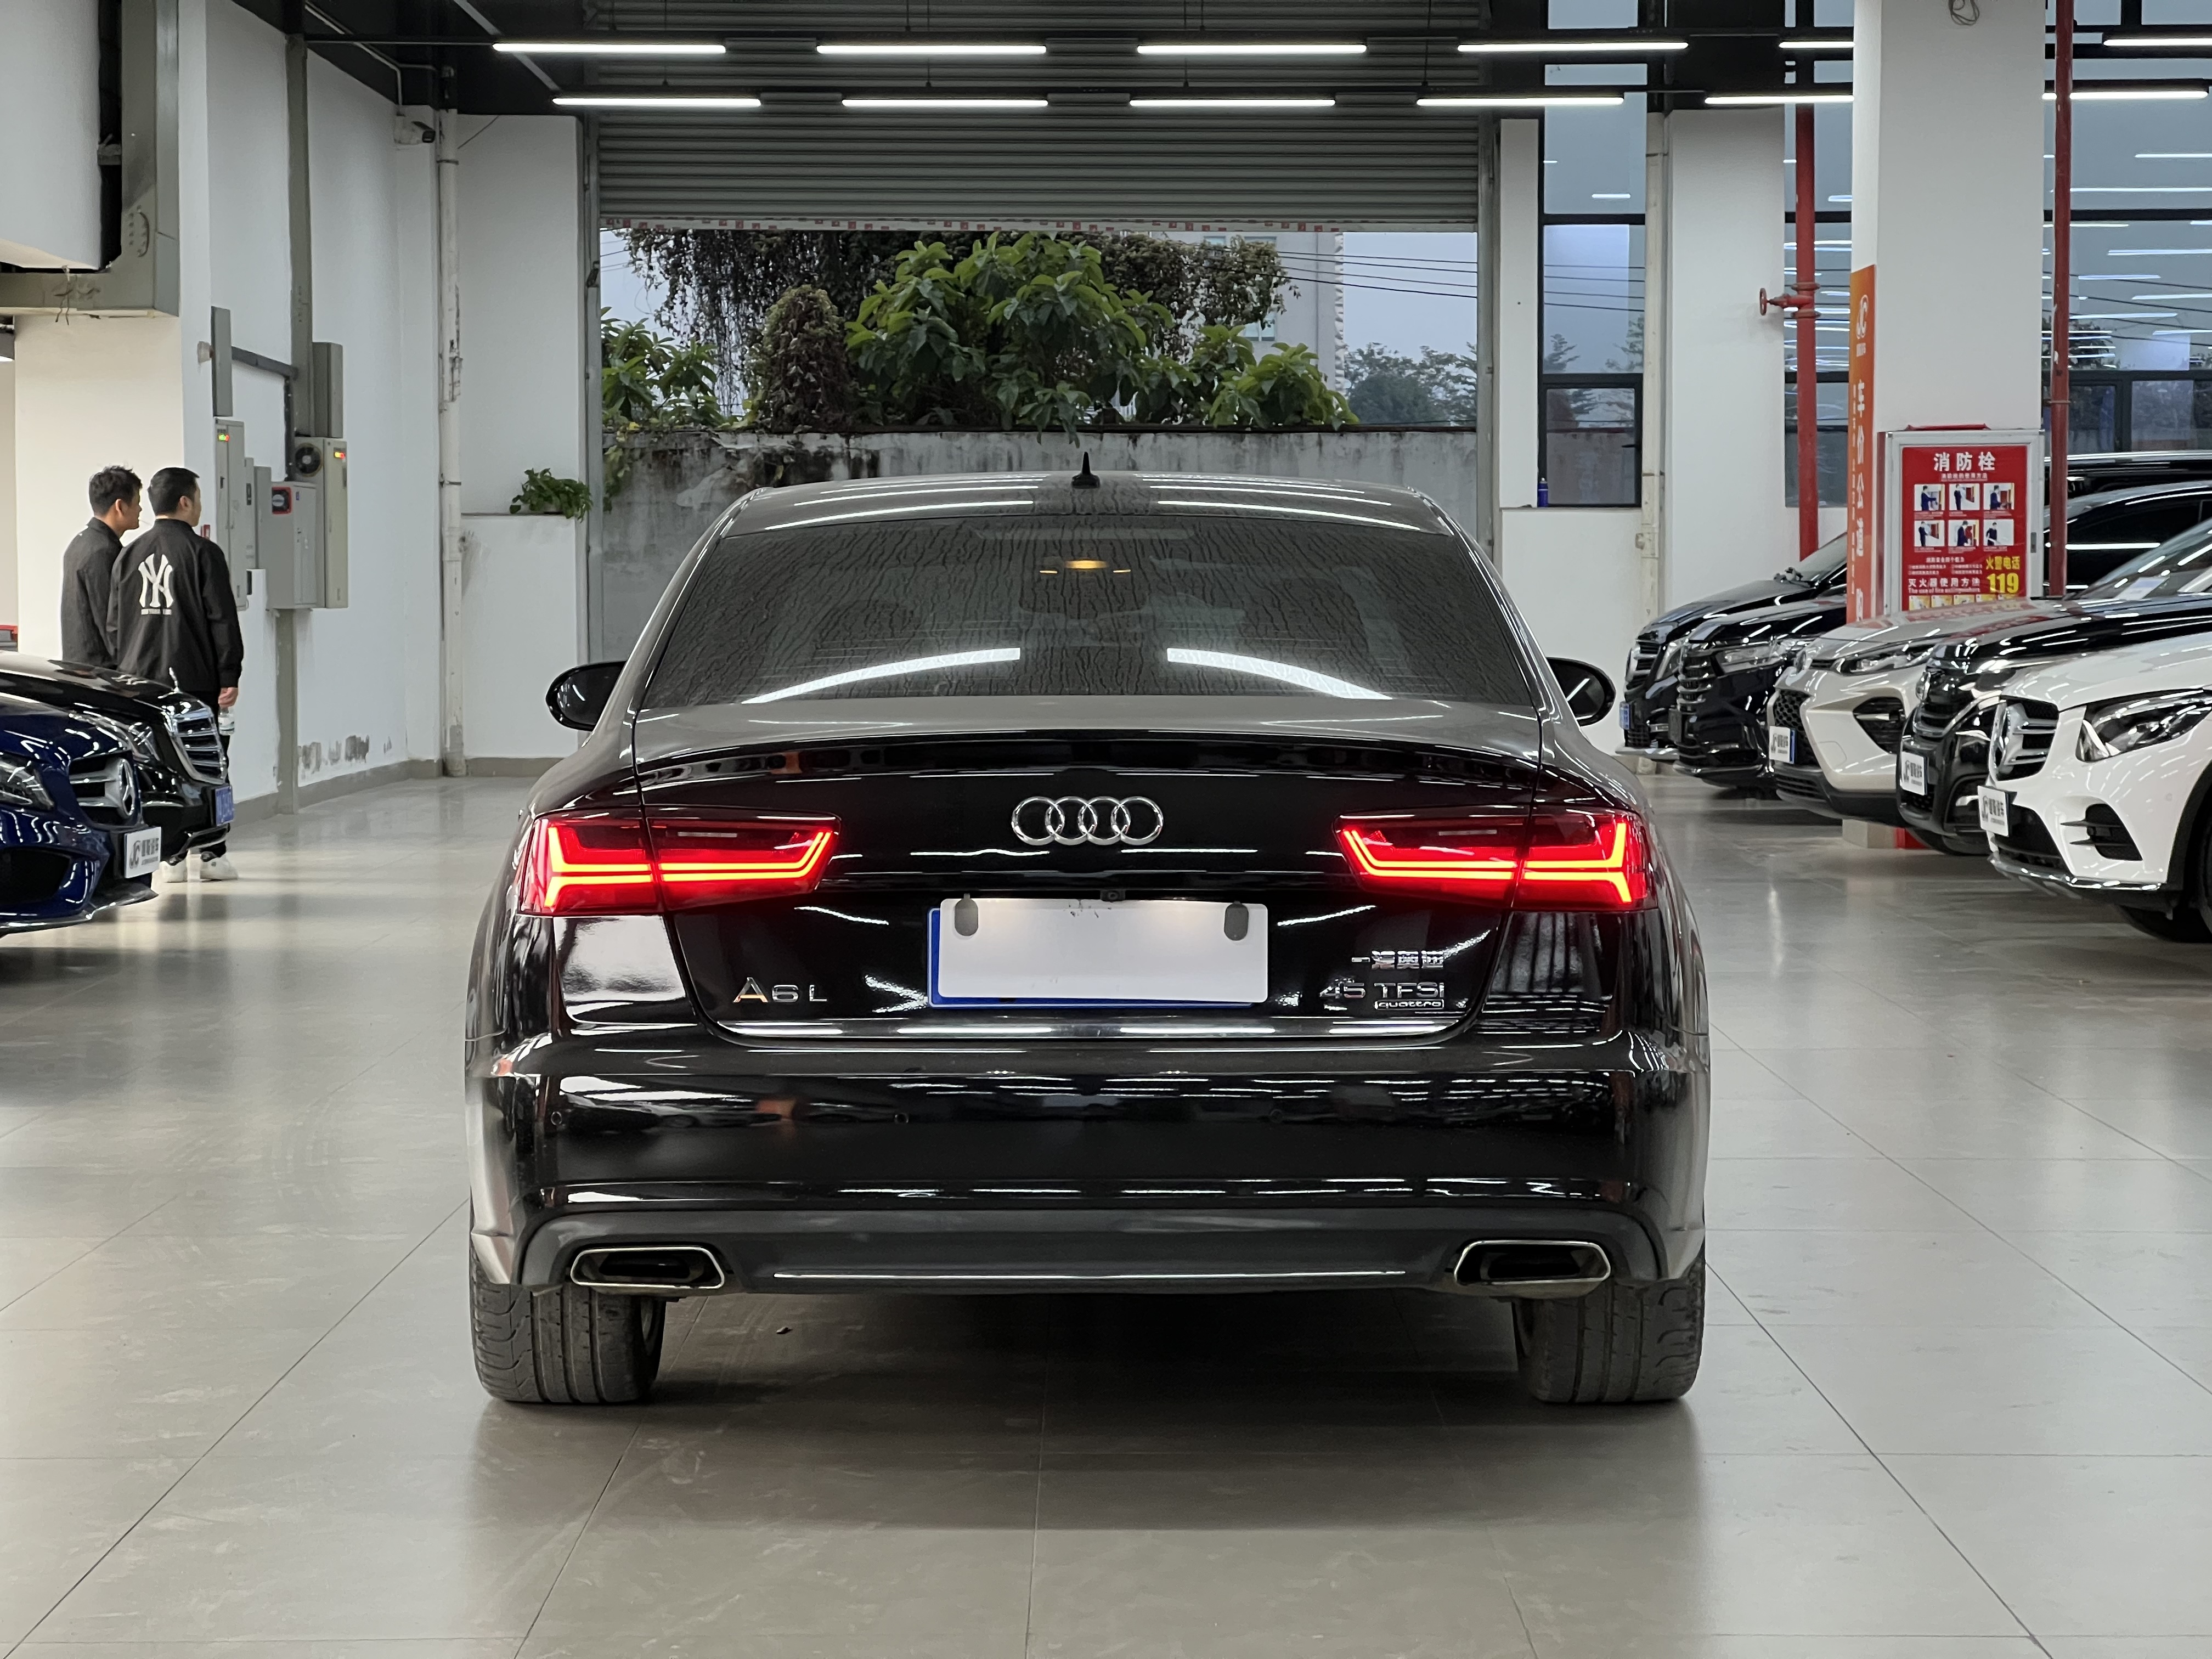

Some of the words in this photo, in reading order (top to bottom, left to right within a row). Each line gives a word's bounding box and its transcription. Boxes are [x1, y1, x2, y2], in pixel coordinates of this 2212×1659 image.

[1933, 452, 1995, 471] 消防栓
[1985, 556, 2021, 570] 火警电话
[138, 554, 173, 608] NY
[1908, 578, 1980, 588] 灭火器使用方法
[1987, 573, 2019, 594] 119
[1319, 981, 1366, 998] 45
[1374, 982, 1444, 998] TFSI
[1379, 1001, 1441, 1009] quattro
